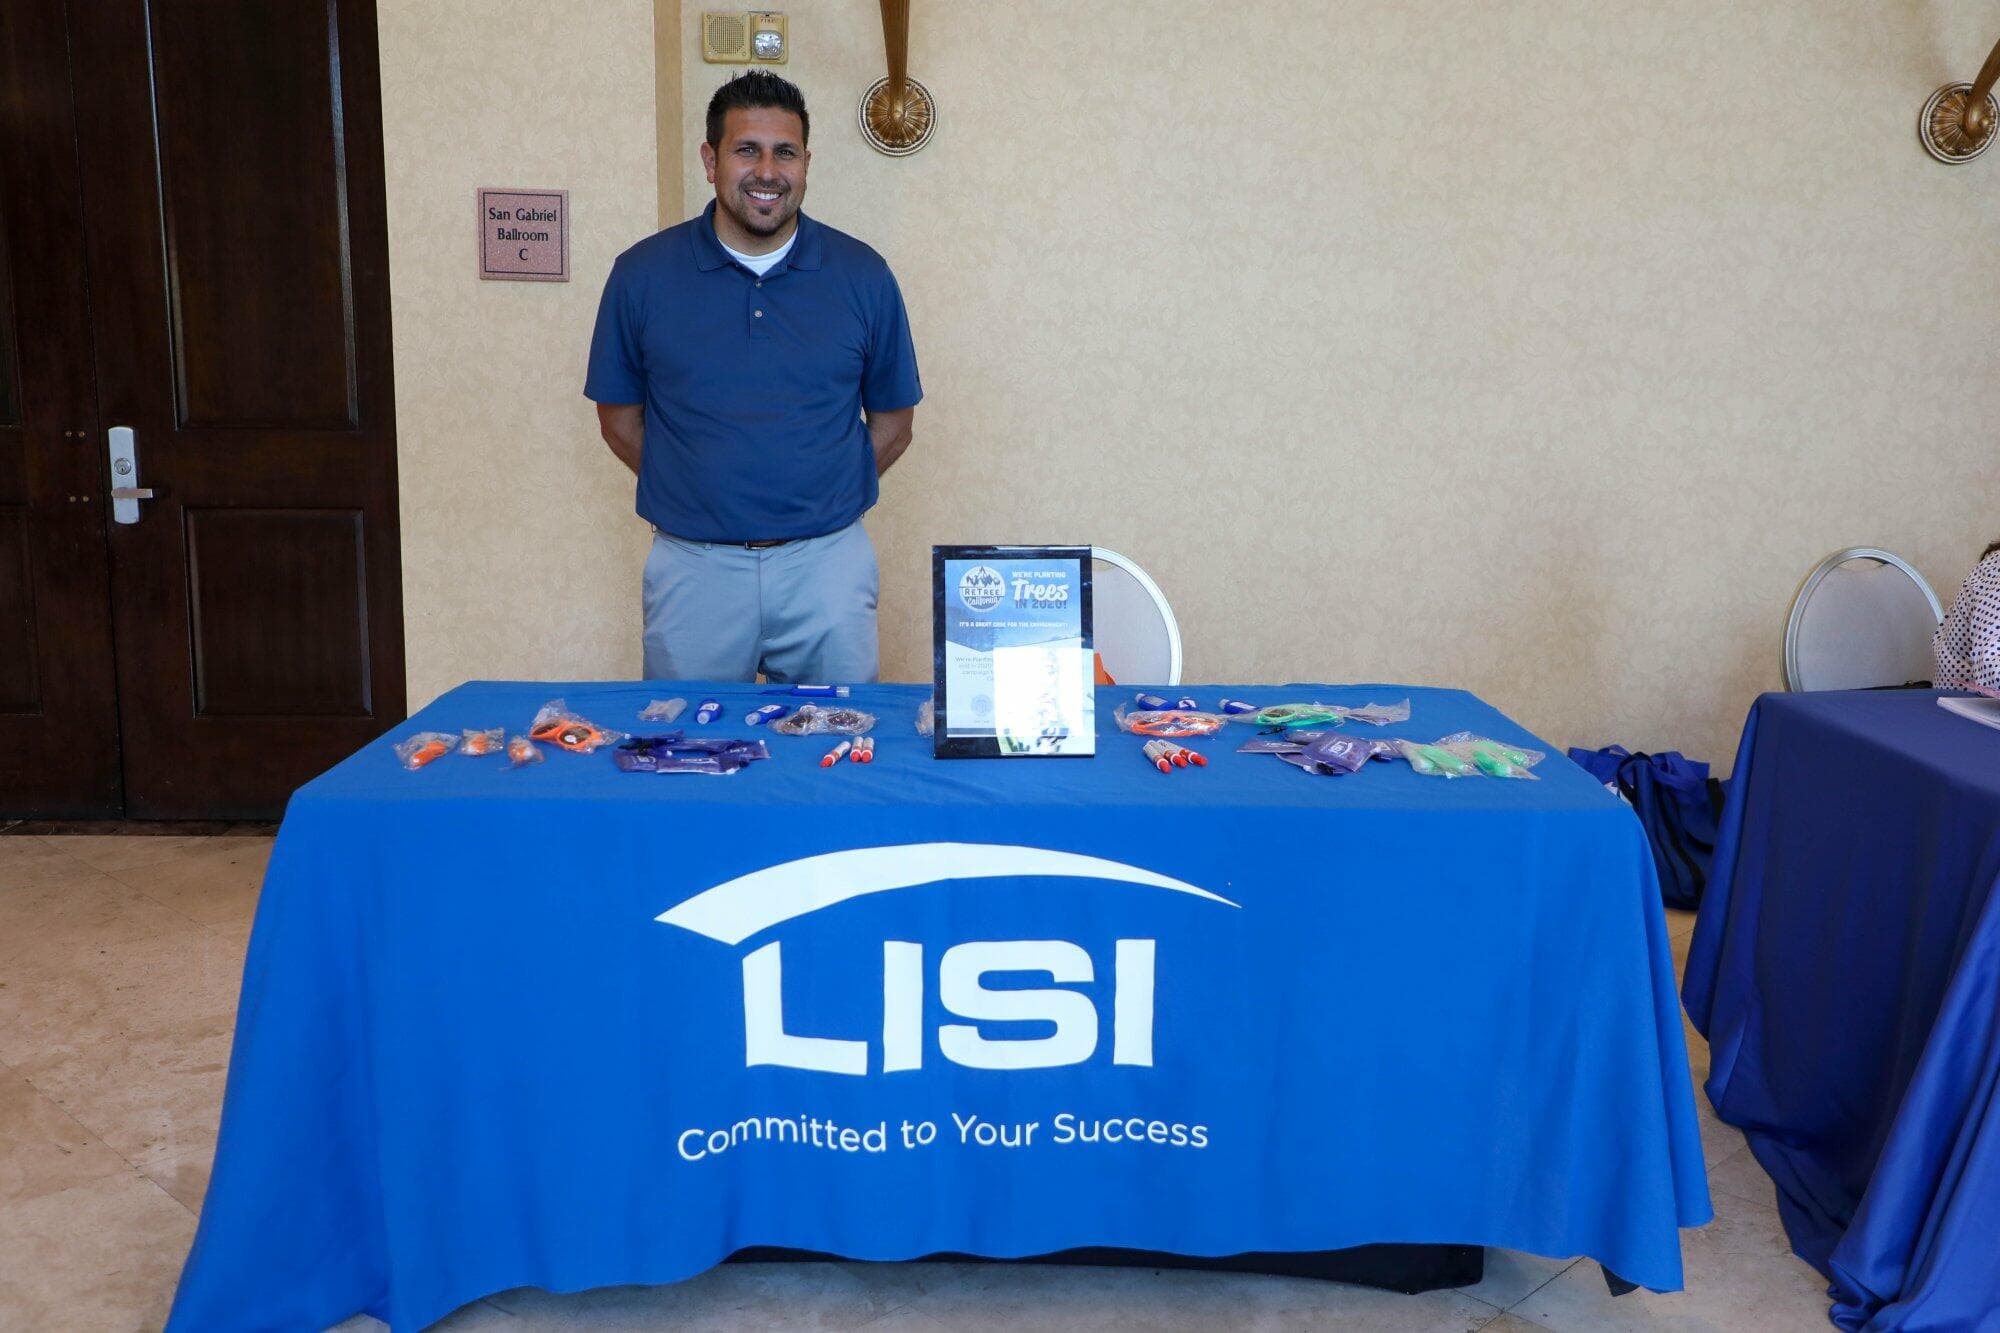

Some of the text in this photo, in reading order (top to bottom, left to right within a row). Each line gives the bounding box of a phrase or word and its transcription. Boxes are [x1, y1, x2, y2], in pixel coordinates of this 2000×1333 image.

[489, 207, 557, 222] San Gabriel
[497, 227, 549, 242] Ballroom
[518, 248, 529, 261] C
[964, 588, 1000, 596] RETREE
[1010, 577, 1070, 602] Trees
[1015, 599, 1067, 609] IN 2020!
[742, 938, 1155, 1075] LISI
[677, 1111, 1209, 1162] Committed to Your Success
